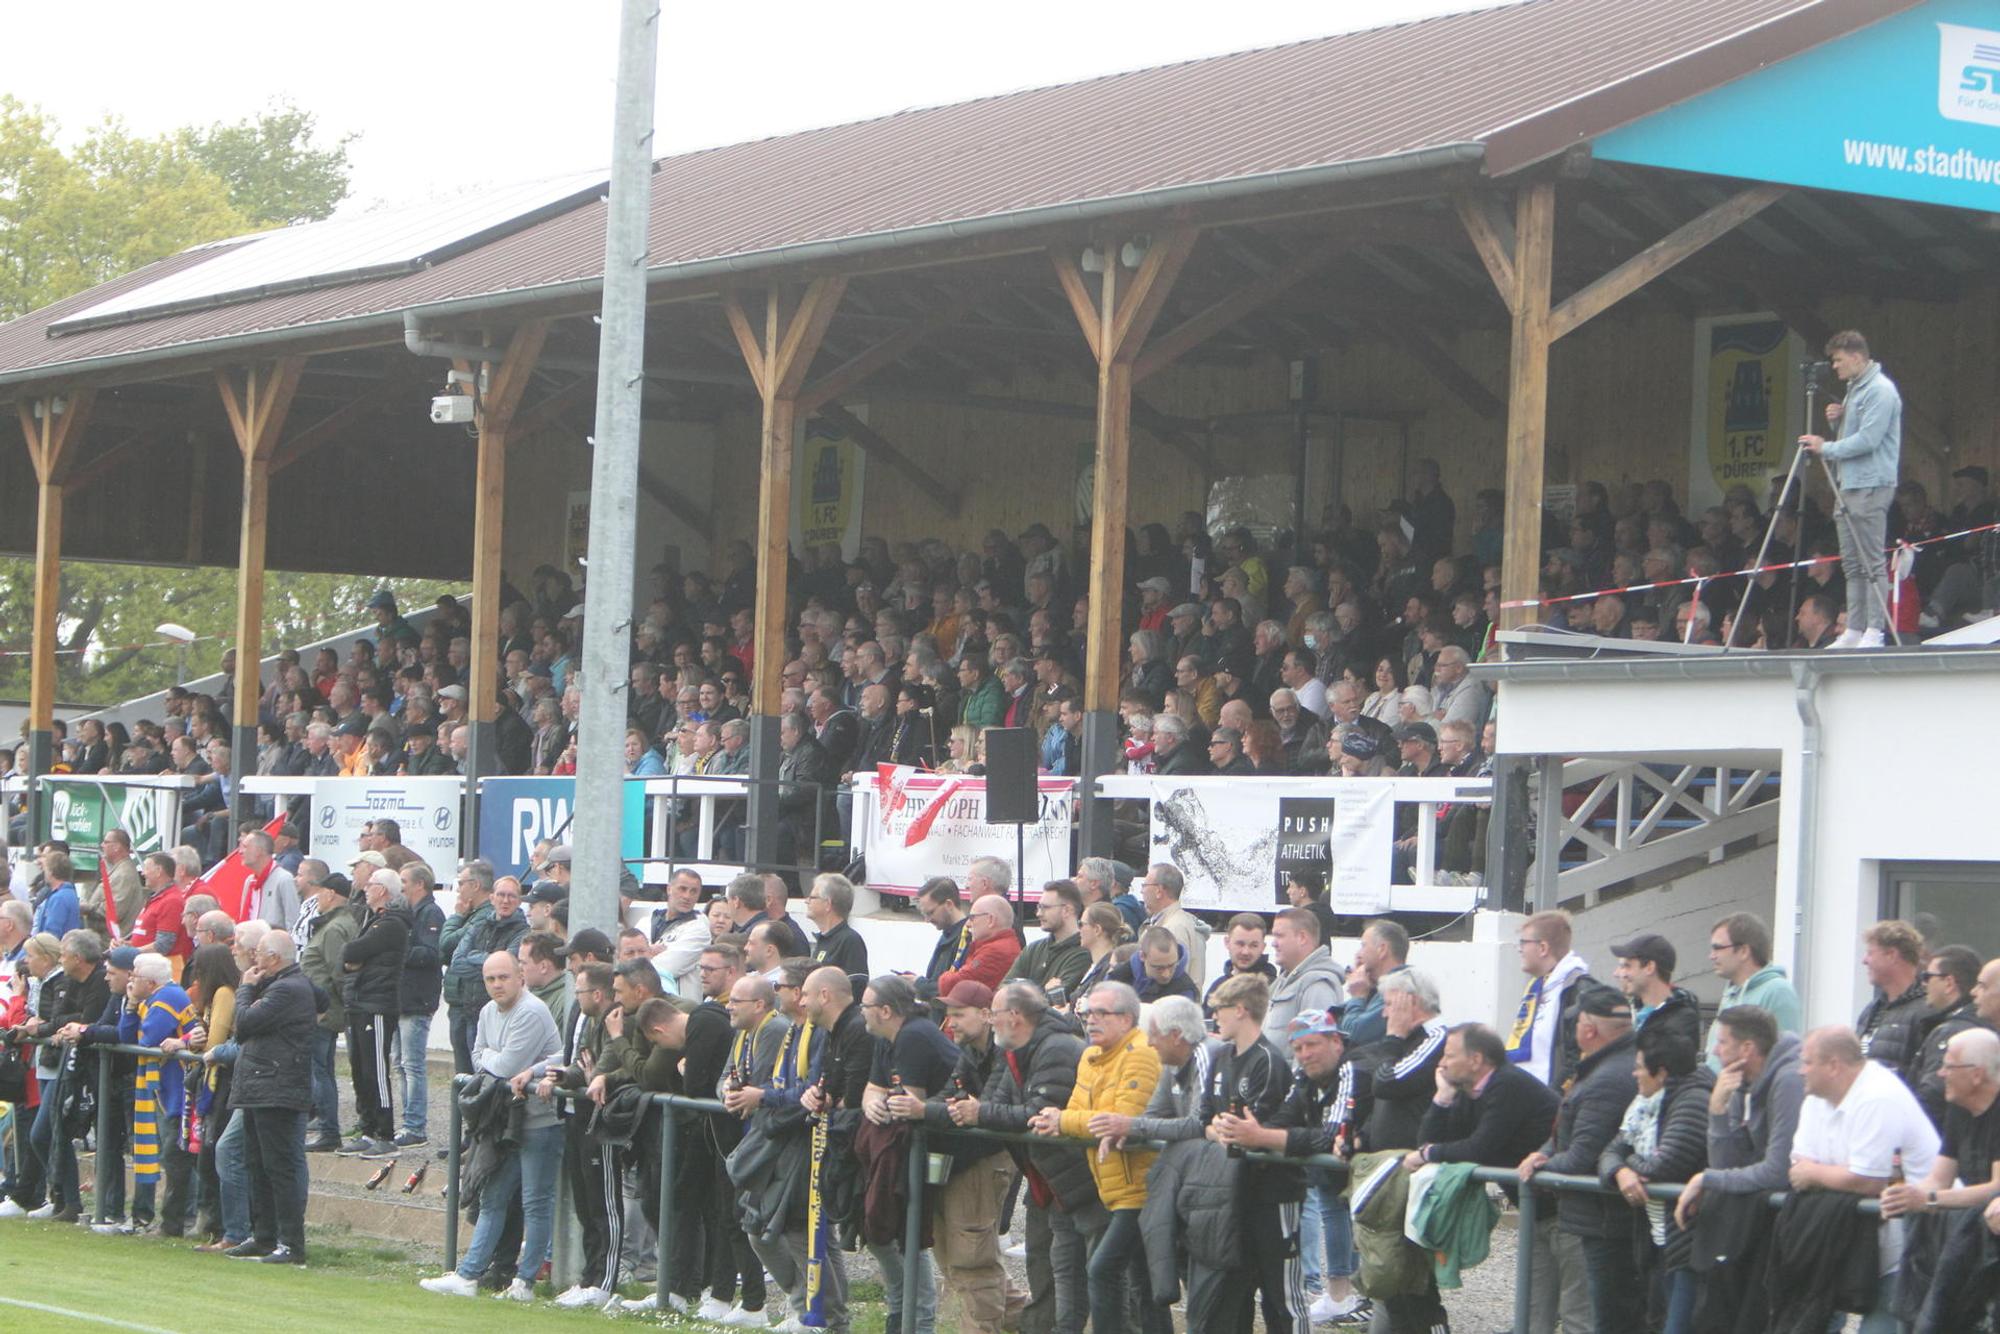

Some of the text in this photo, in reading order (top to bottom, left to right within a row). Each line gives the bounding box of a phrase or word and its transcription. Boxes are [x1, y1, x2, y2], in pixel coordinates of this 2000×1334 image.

[1743, 435, 1764, 457] FC
[511, 797, 576, 865] RW
[1283, 816, 1329, 833] PUSH
[1280, 844, 1326, 861] ATHLETIK
